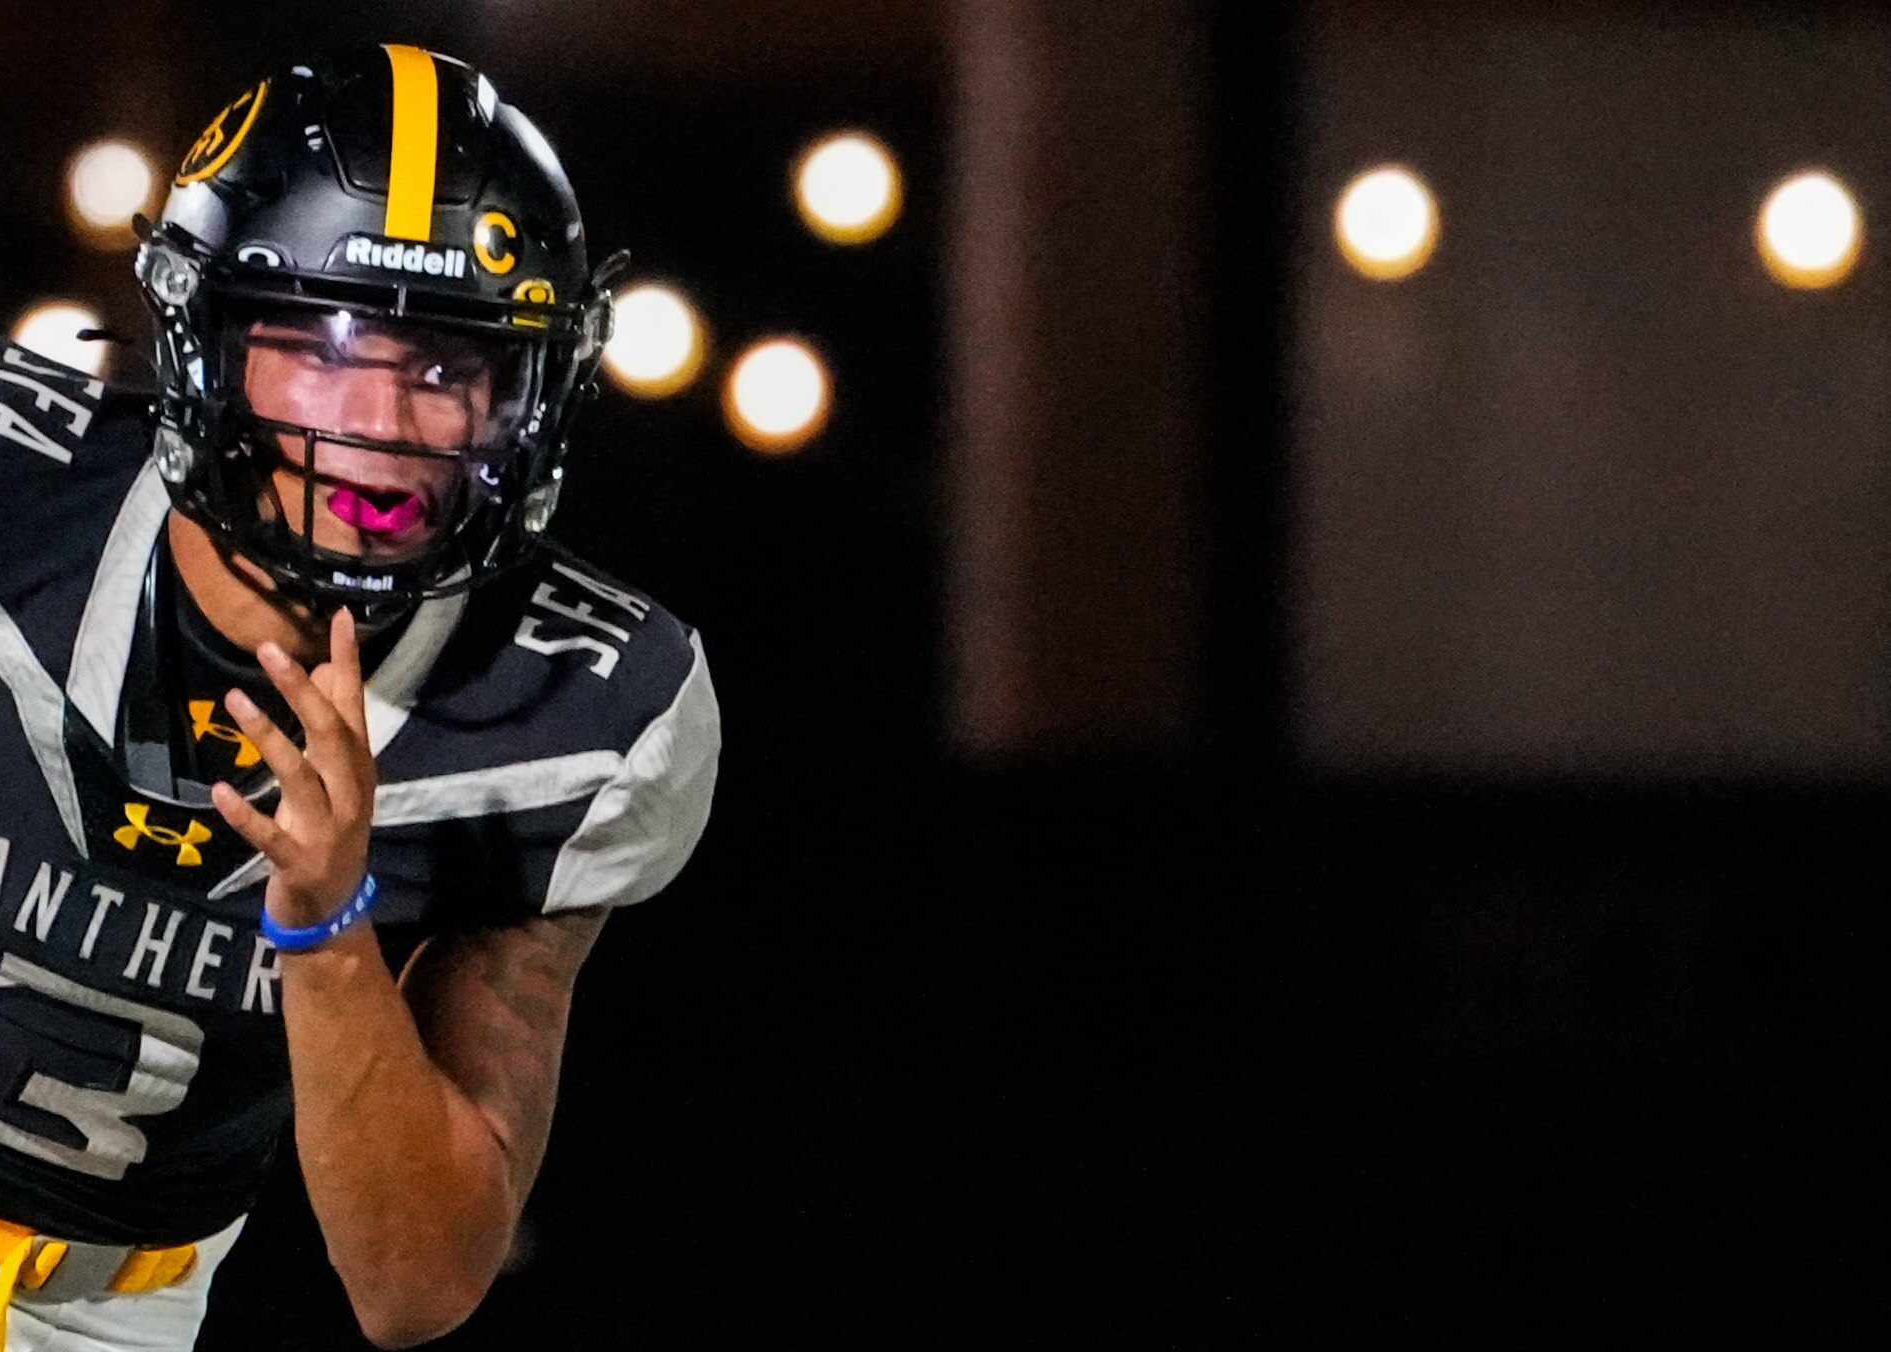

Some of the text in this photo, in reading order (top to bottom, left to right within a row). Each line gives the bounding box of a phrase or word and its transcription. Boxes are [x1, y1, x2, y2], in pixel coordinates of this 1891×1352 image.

[346, 236, 466, 279] Riddell
[473, 211, 516, 275] C
[514, 561, 650, 680] SFA
